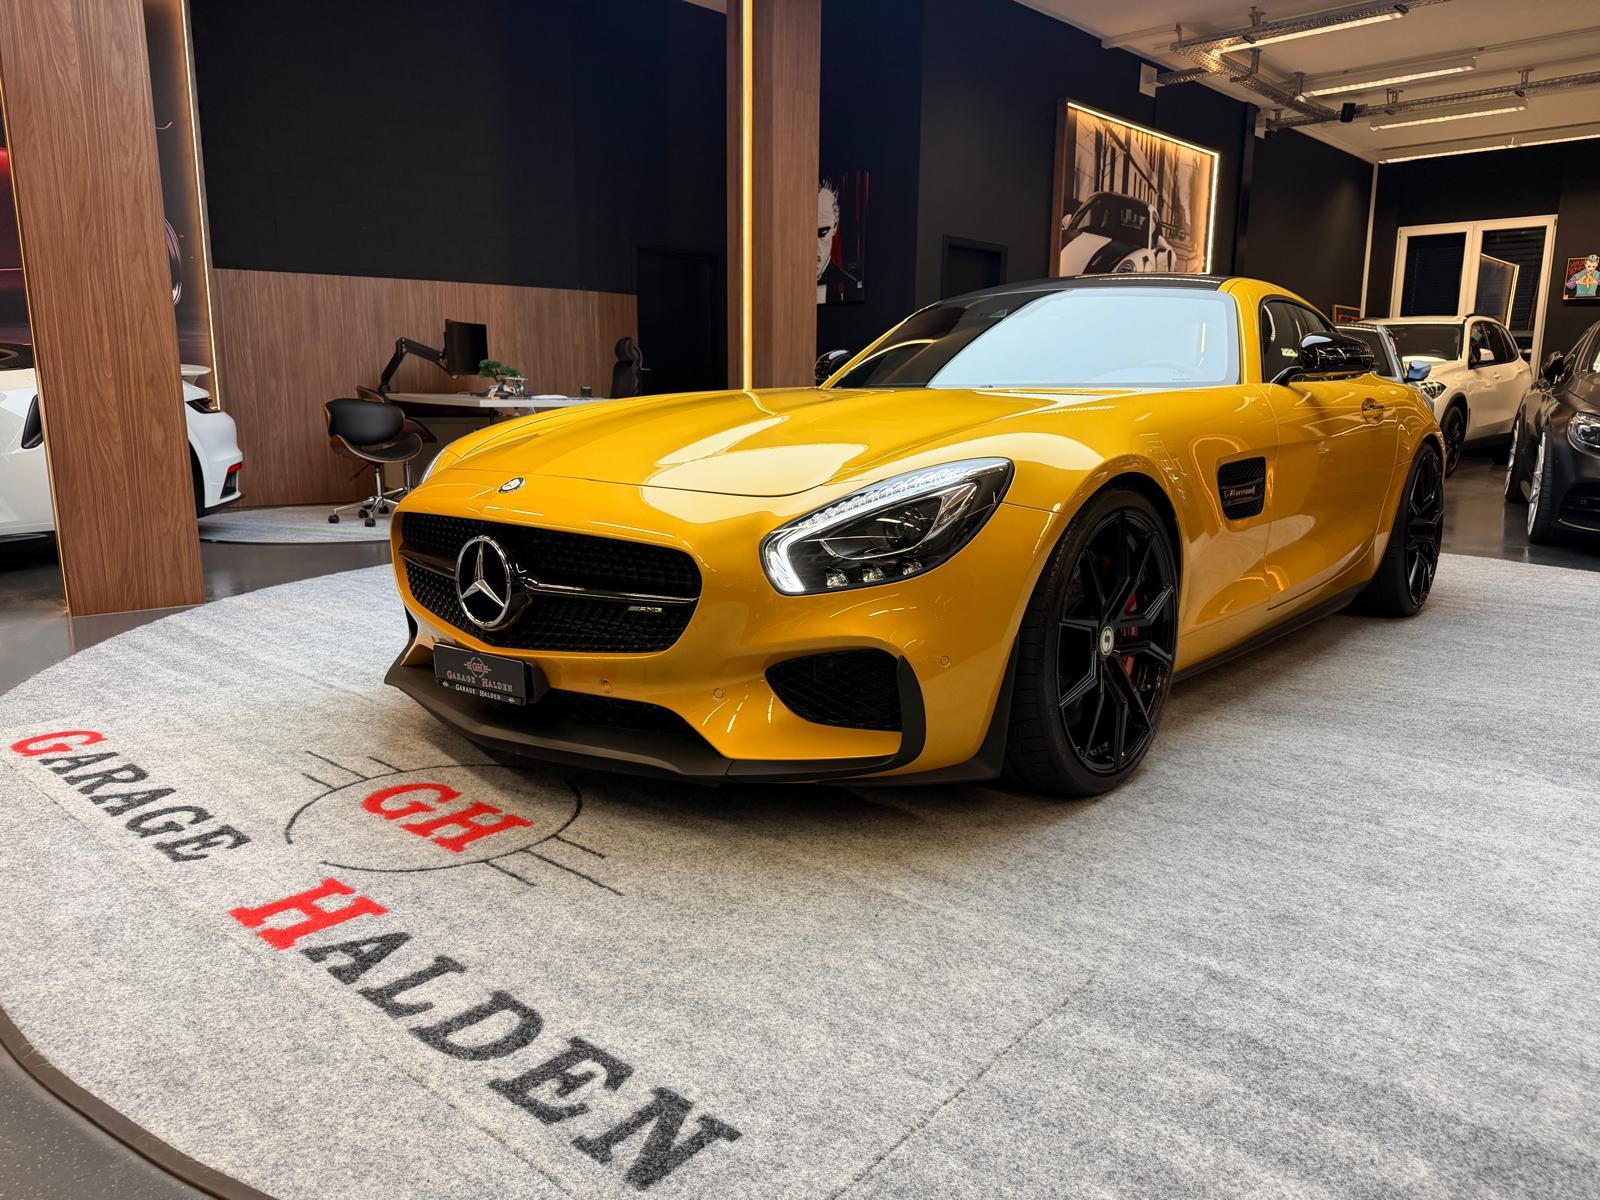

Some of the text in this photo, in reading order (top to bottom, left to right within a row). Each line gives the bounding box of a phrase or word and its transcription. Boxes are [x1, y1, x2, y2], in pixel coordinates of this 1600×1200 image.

[446, 670, 513, 693] GARAGE HALDEN
[455, 684, 501, 701] GARAGE HALDEN
[361, 781, 535, 853] GH
[10, 730, 742, 1188] GARAGE HALDEN
